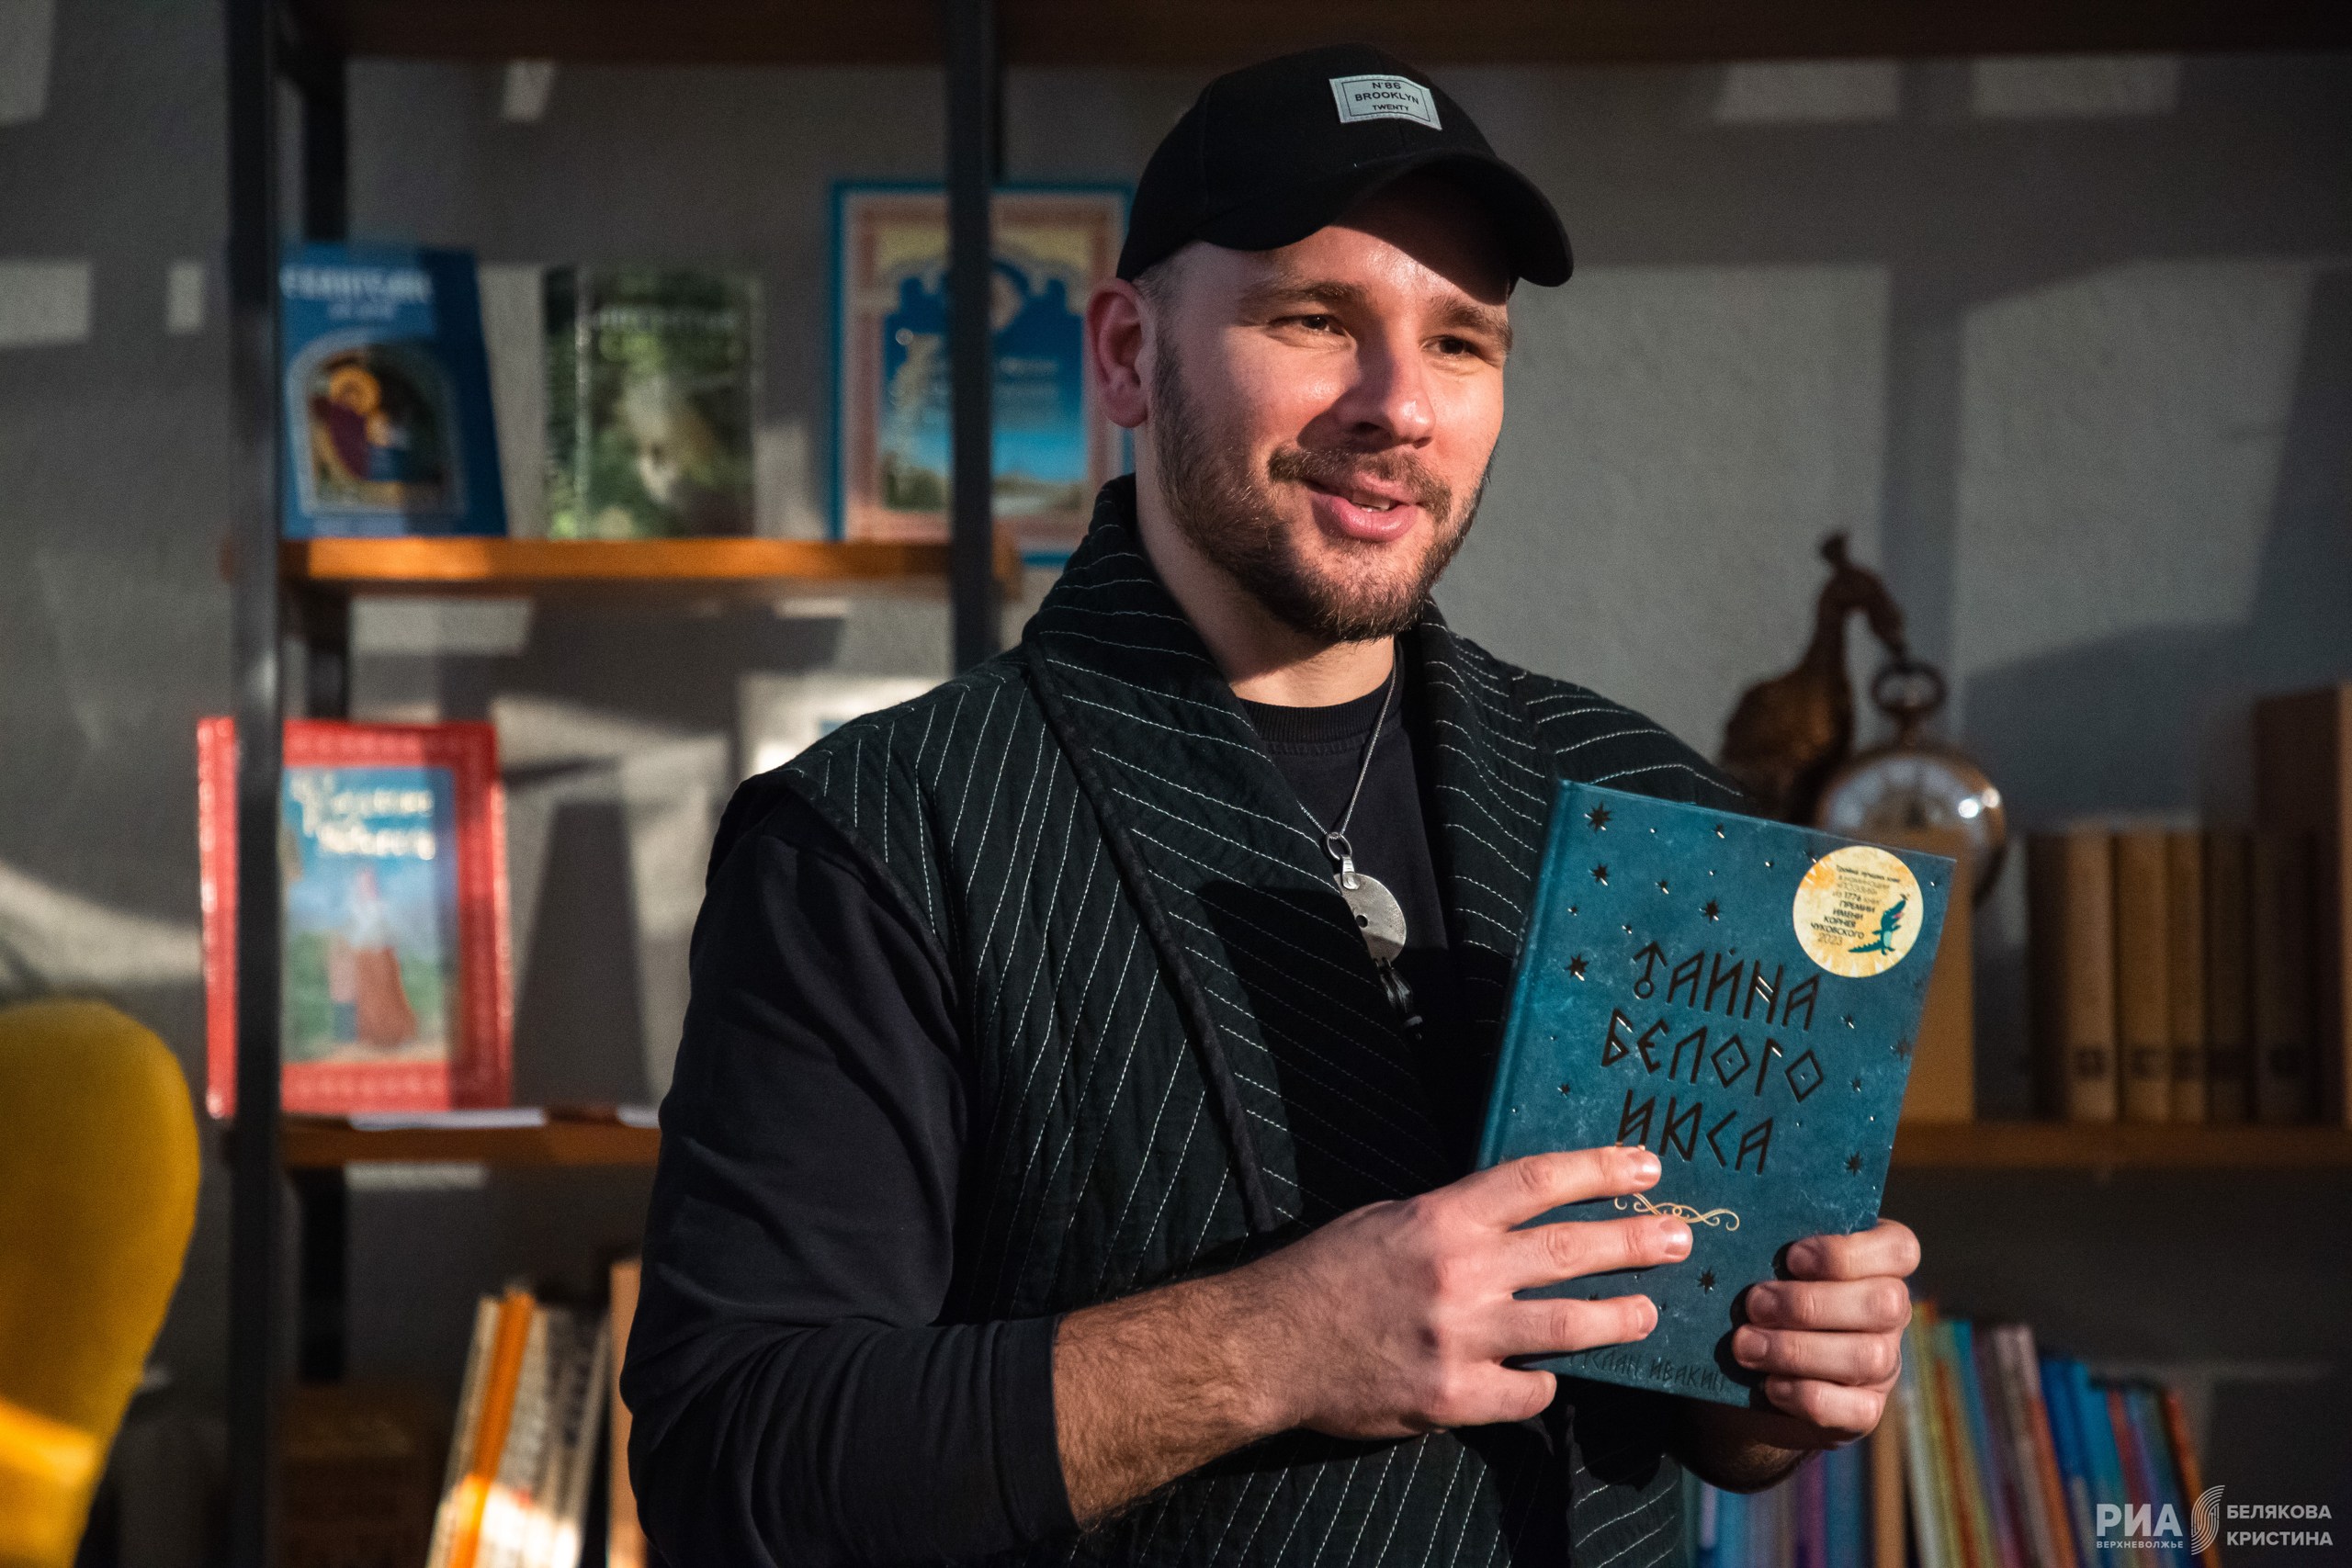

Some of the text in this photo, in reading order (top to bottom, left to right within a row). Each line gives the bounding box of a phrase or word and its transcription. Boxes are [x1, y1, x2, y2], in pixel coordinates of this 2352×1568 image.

[1354, 91, 1419, 105] BROOKLYN
[1373, 104, 1409, 112] TWENTY
[1810, 921, 1865, 940] ЧУКОВСКОГО
[1817, 932, 1843, 946] 2023
[1632, 940, 1821, 1032] ТАЙНА
[1600, 1008, 1824, 1103] БЕЛОГО
[1615, 1089, 1774, 1176] ИЮСА
